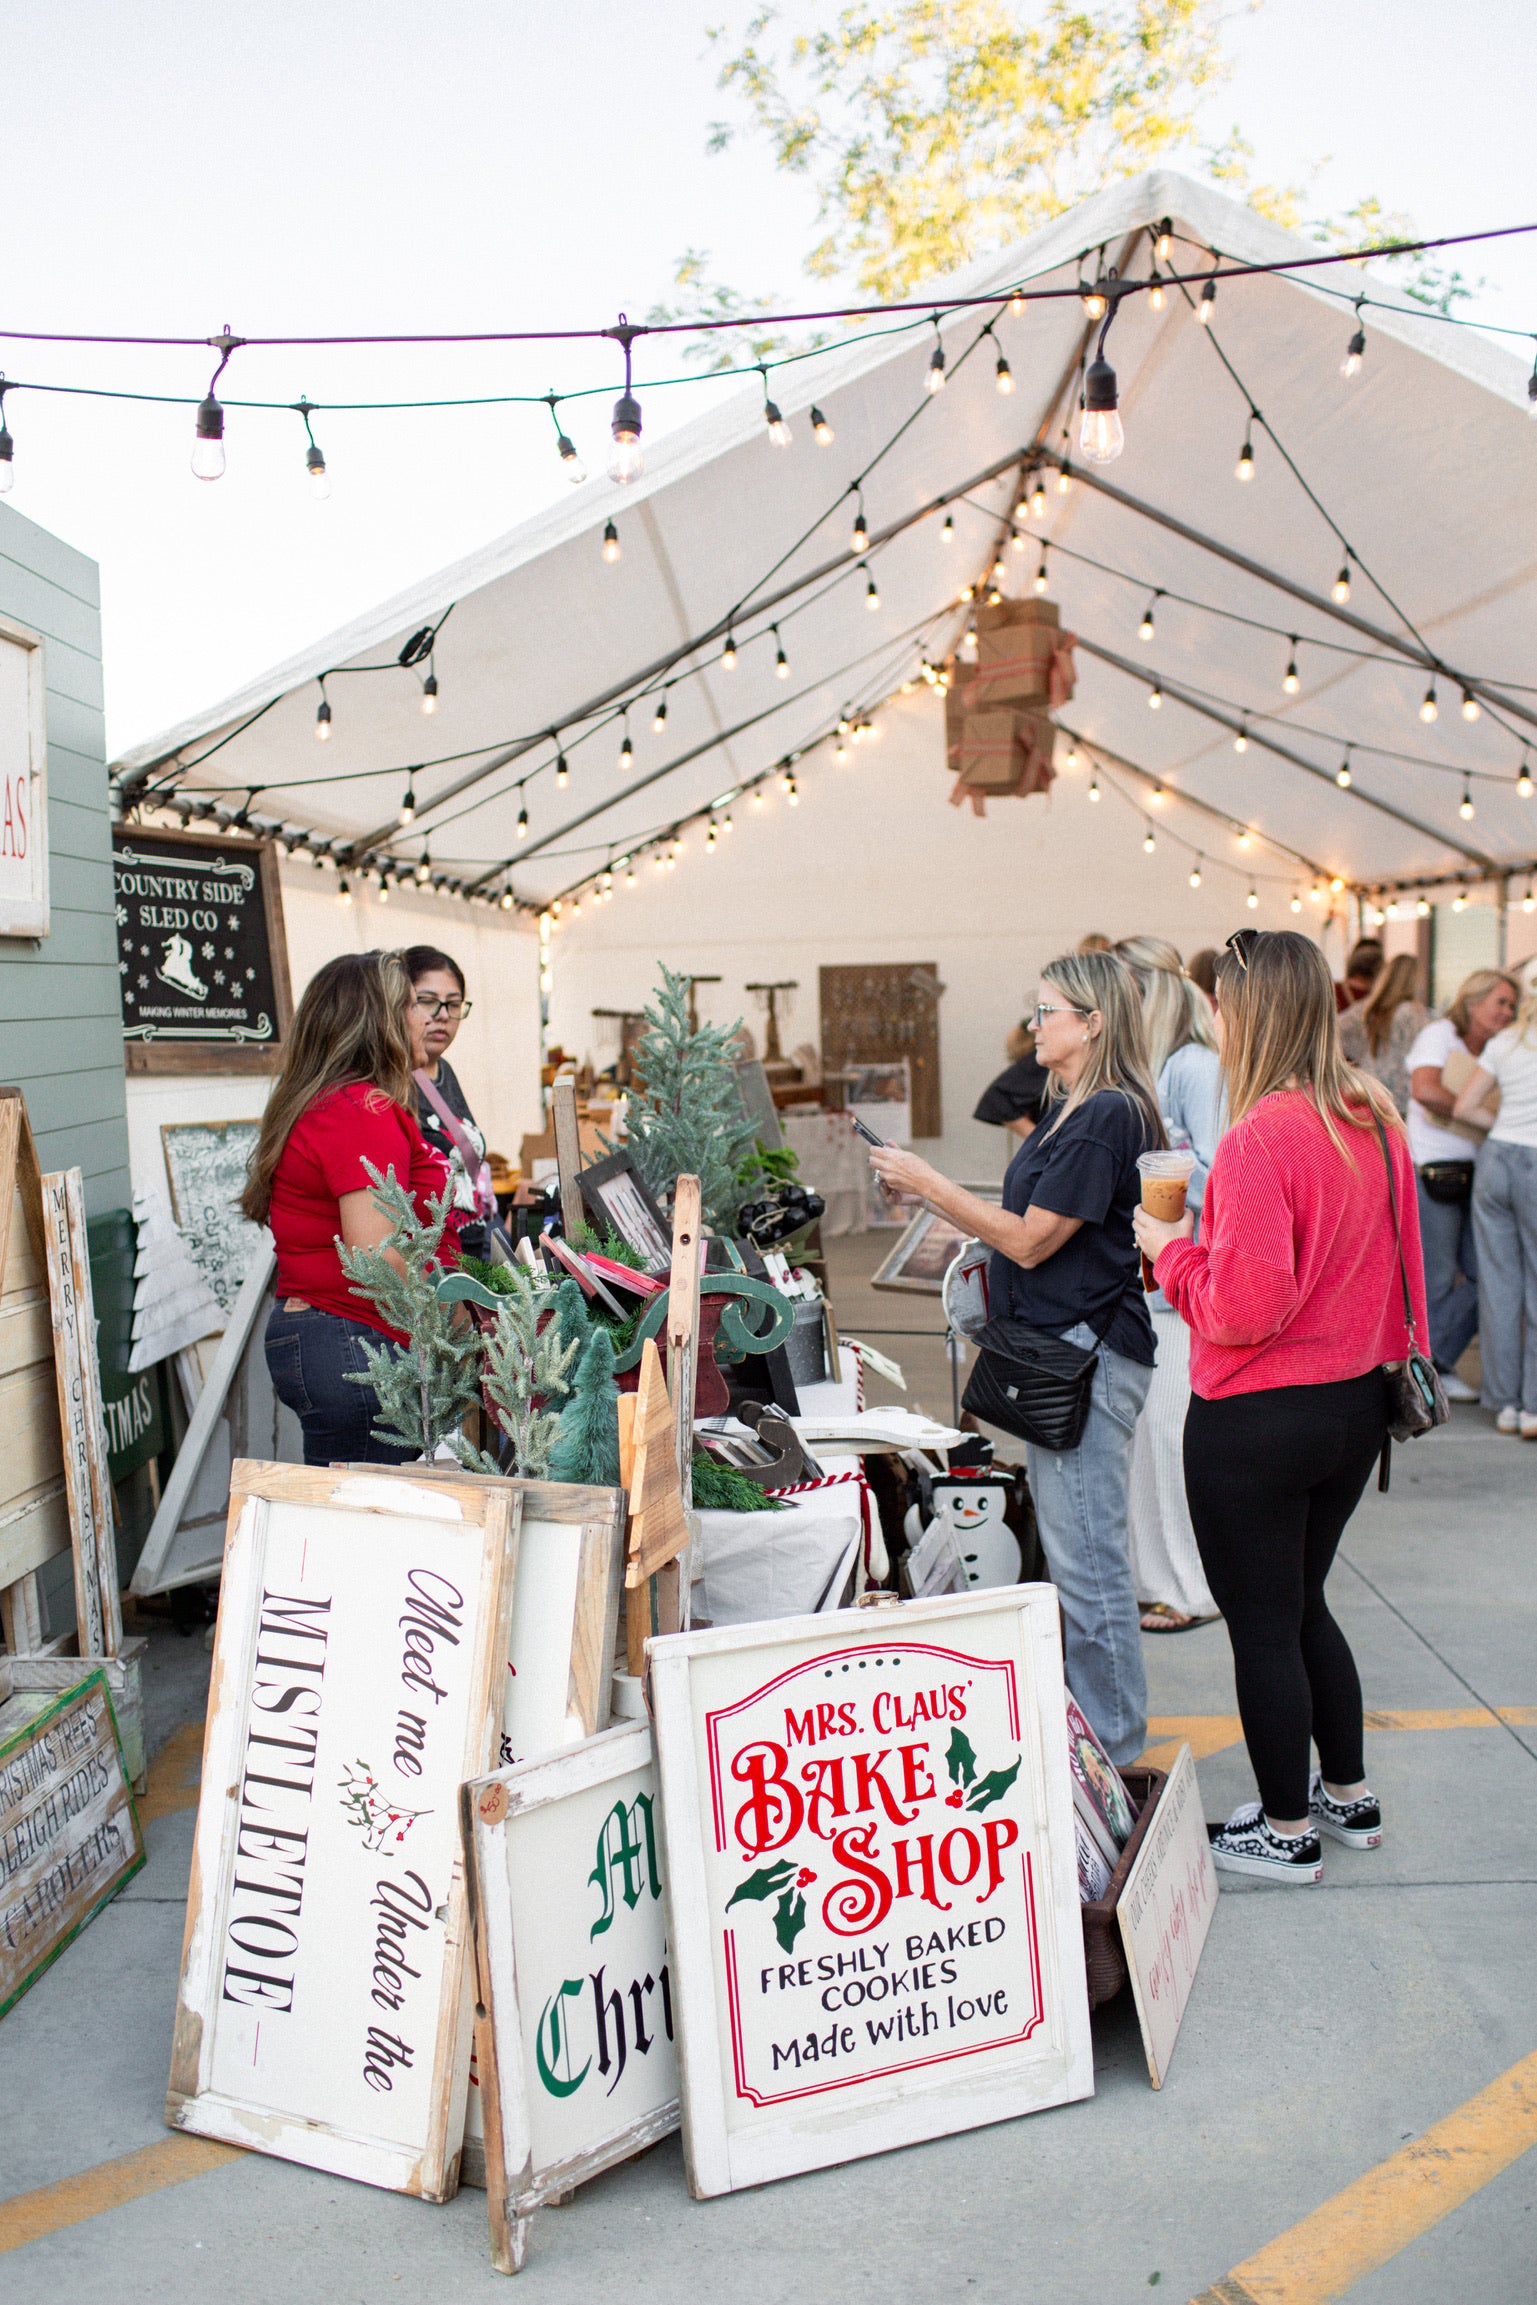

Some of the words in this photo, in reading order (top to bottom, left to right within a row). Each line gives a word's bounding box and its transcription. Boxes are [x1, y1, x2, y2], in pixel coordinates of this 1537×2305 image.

[140, 905, 190, 930] SLED
[192, 909, 218, 932] CO
[202, 881, 246, 905] SIDE
[139, 1006, 172, 1018] MAKING
[173, 1006, 204, 1019] WINTER
[205, 1007, 248, 1020] MEMORIES
[53, 1186, 75, 1339] MERRY
[72, 1377, 99, 1654] CHRISTMAS
[399, 1569, 464, 1706] Meet
[0, 1732, 57, 1817] RISTMAS
[53, 1700, 98, 1763] TREES
[393, 1710, 428, 1778] me
[784, 1701, 864, 1748] MRS.
[59, 1750, 109, 1823] RIDES
[222, 1588, 332, 2014] MISTLETOE
[732, 1741, 937, 1861] BAKE
[4, 1820, 121, 1949] CAROLERS
[822, 1818, 1019, 1937] SHOP
[368, 1869, 434, 2019] Under
[761, 1942, 889, 1993] FRESHLY
[906, 1917, 1006, 1961] BAKED
[821, 1960, 958, 2012] COOKIES
[866, 2002, 939, 2043] with
[947, 1987, 1008, 2029] love
[362, 2026, 412, 2093] the
